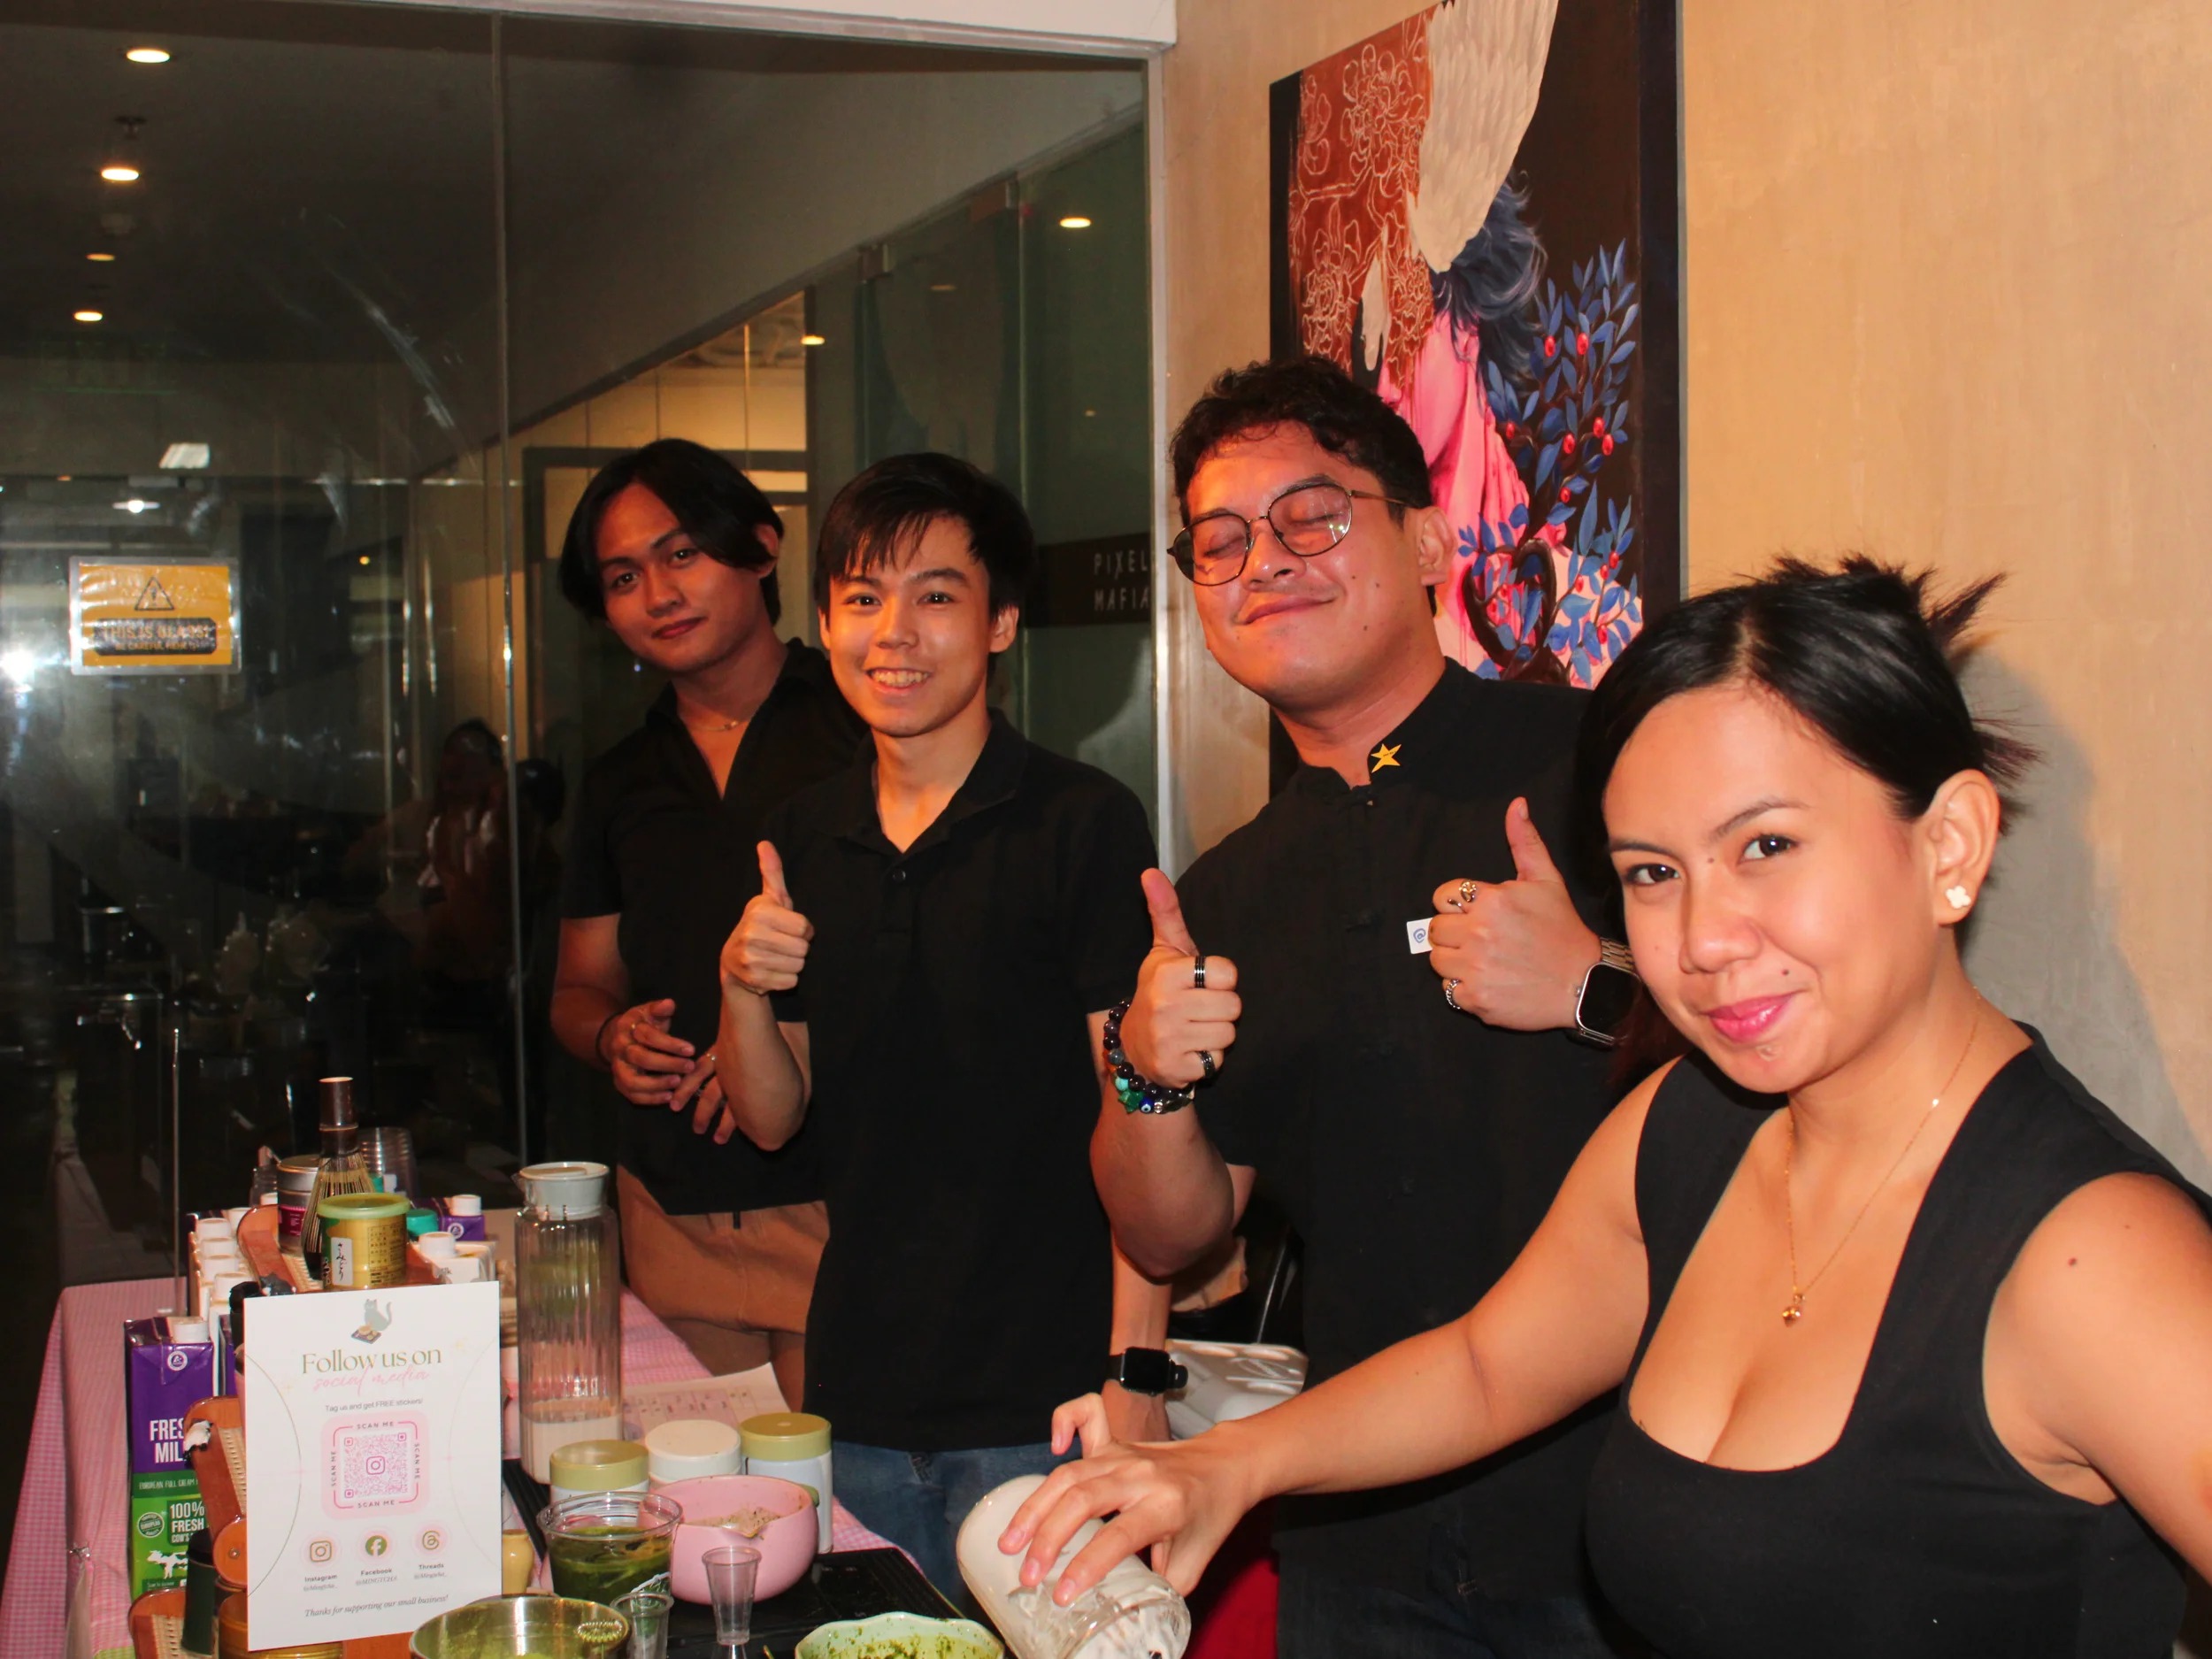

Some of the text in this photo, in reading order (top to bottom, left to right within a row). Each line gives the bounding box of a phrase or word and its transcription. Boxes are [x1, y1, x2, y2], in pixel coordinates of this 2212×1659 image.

[1094, 549, 1148, 580] PIXEL
[1094, 587, 1149, 611] MAFIA
[303, 1348, 442, 1374] Follow us on
[313, 1364, 430, 1396] social media
[326, 1404, 338, 1413] Tag
[363, 1402, 374, 1410] get
[149, 1417, 185, 1441] FRES
[154, 1441, 186, 1464] MIL
[414, 1468, 420, 1479] ME
[170, 1501, 205, 1519] 100%
[171, 1517, 204, 1533] FRESH
[304, 1574, 338, 1583] Instagram
[304, 1607, 331, 1617] Thanks
[332, 1606, 343, 1616] for
[344, 1601, 383, 1613] supporting
[398, 1597, 417, 1606] small
[418, 1594, 449, 1604] business!
